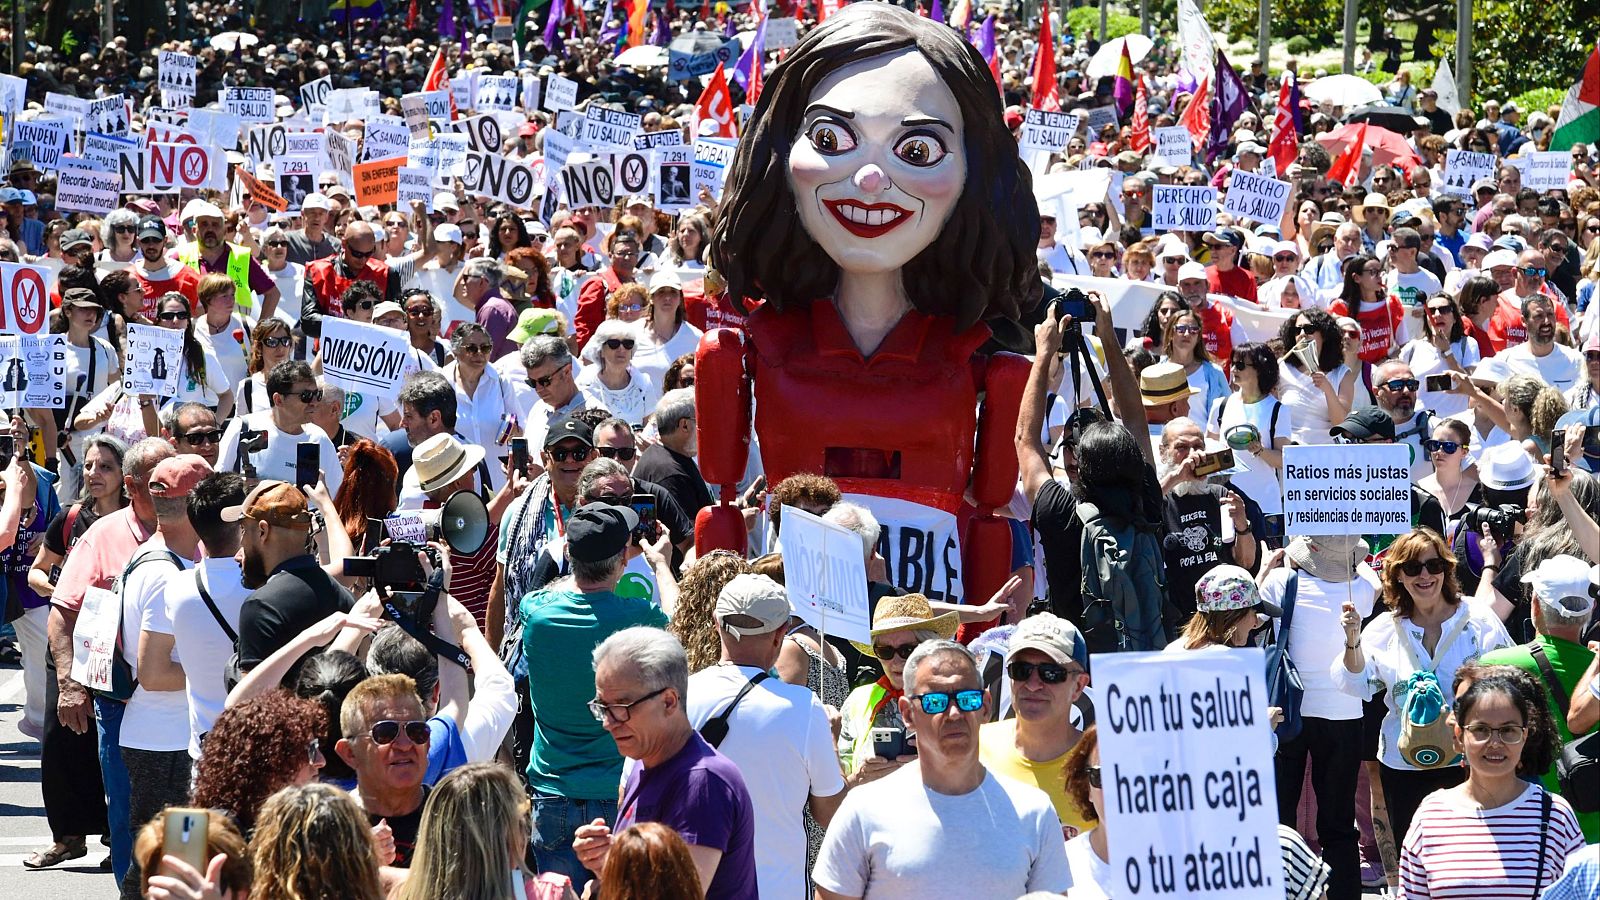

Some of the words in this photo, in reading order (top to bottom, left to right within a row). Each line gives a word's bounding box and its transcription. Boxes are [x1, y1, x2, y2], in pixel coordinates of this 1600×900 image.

[227, 88, 238, 100] SE
[241, 89, 271, 100] VENDE
[240, 103, 270, 118] SALUD.
[588, 106, 601, 120] SE
[604, 110, 640, 128] VENDE
[1028, 109, 1041, 125] SE
[1044, 113, 1077, 128] VENDE
[18, 124, 59, 147] VENDEN
[250, 125, 287, 162] NO
[587, 123, 600, 139] TU
[600, 127, 632, 147] SALUD.
[635, 136, 648, 150] SE
[648, 132, 680, 147] VENDE
[1028, 128, 1040, 144] TU
[150, 144, 209, 185] NO
[283, 161, 309, 172] 7.291
[663, 151, 687, 162] 7.291
[60, 172, 91, 188] Recortar
[90, 177, 121, 193] Sanidad,
[362, 172, 372, 182] SIN
[478, 153, 533, 205] NO
[610, 153, 648, 193] O
[362, 186, 371, 197] NO
[384, 181, 399, 193] CUIDA
[569, 165, 614, 204] NO
[1233, 173, 1285, 199] DERECHO
[58, 192, 94, 206] corrupción
[1157, 188, 1212, 204] DERECHO
[1155, 214, 1163, 225] a
[1167, 208, 1176, 225] la
[1179, 207, 1213, 226] SALUD.
[1226, 198, 1235, 209] a
[1237, 195, 1247, 213] la
[1246, 199, 1281, 222] SALUD.
[0, 266, 46, 334] O
[322, 336, 406, 380] DIMISIÓN!
[1286, 464, 1330, 480] Ratios
[1334, 463, 1363, 480] más
[1365, 464, 1409, 483] justas
[1287, 489, 1301, 501] en
[1304, 486, 1357, 501] servicios
[1360, 486, 1409, 501] sociales
[1288, 511, 1294, 527] y
[1296, 508, 1349, 523] residencias
[1351, 508, 1363, 523] de
[1365, 511, 1409, 527] mayores.
[391, 526, 404, 537] NO
[1180, 555, 1196, 568] POR
[1107, 683, 1155, 735] Con
[1160, 683, 1184, 731] tu
[1190, 676, 1255, 730] salud
[1114, 759, 1195, 815] harán
[1204, 756, 1263, 822] caja
[1125, 856, 1141, 895] o
[1148, 845, 1176, 894] tu
[1184, 836, 1272, 893] ataúd.
